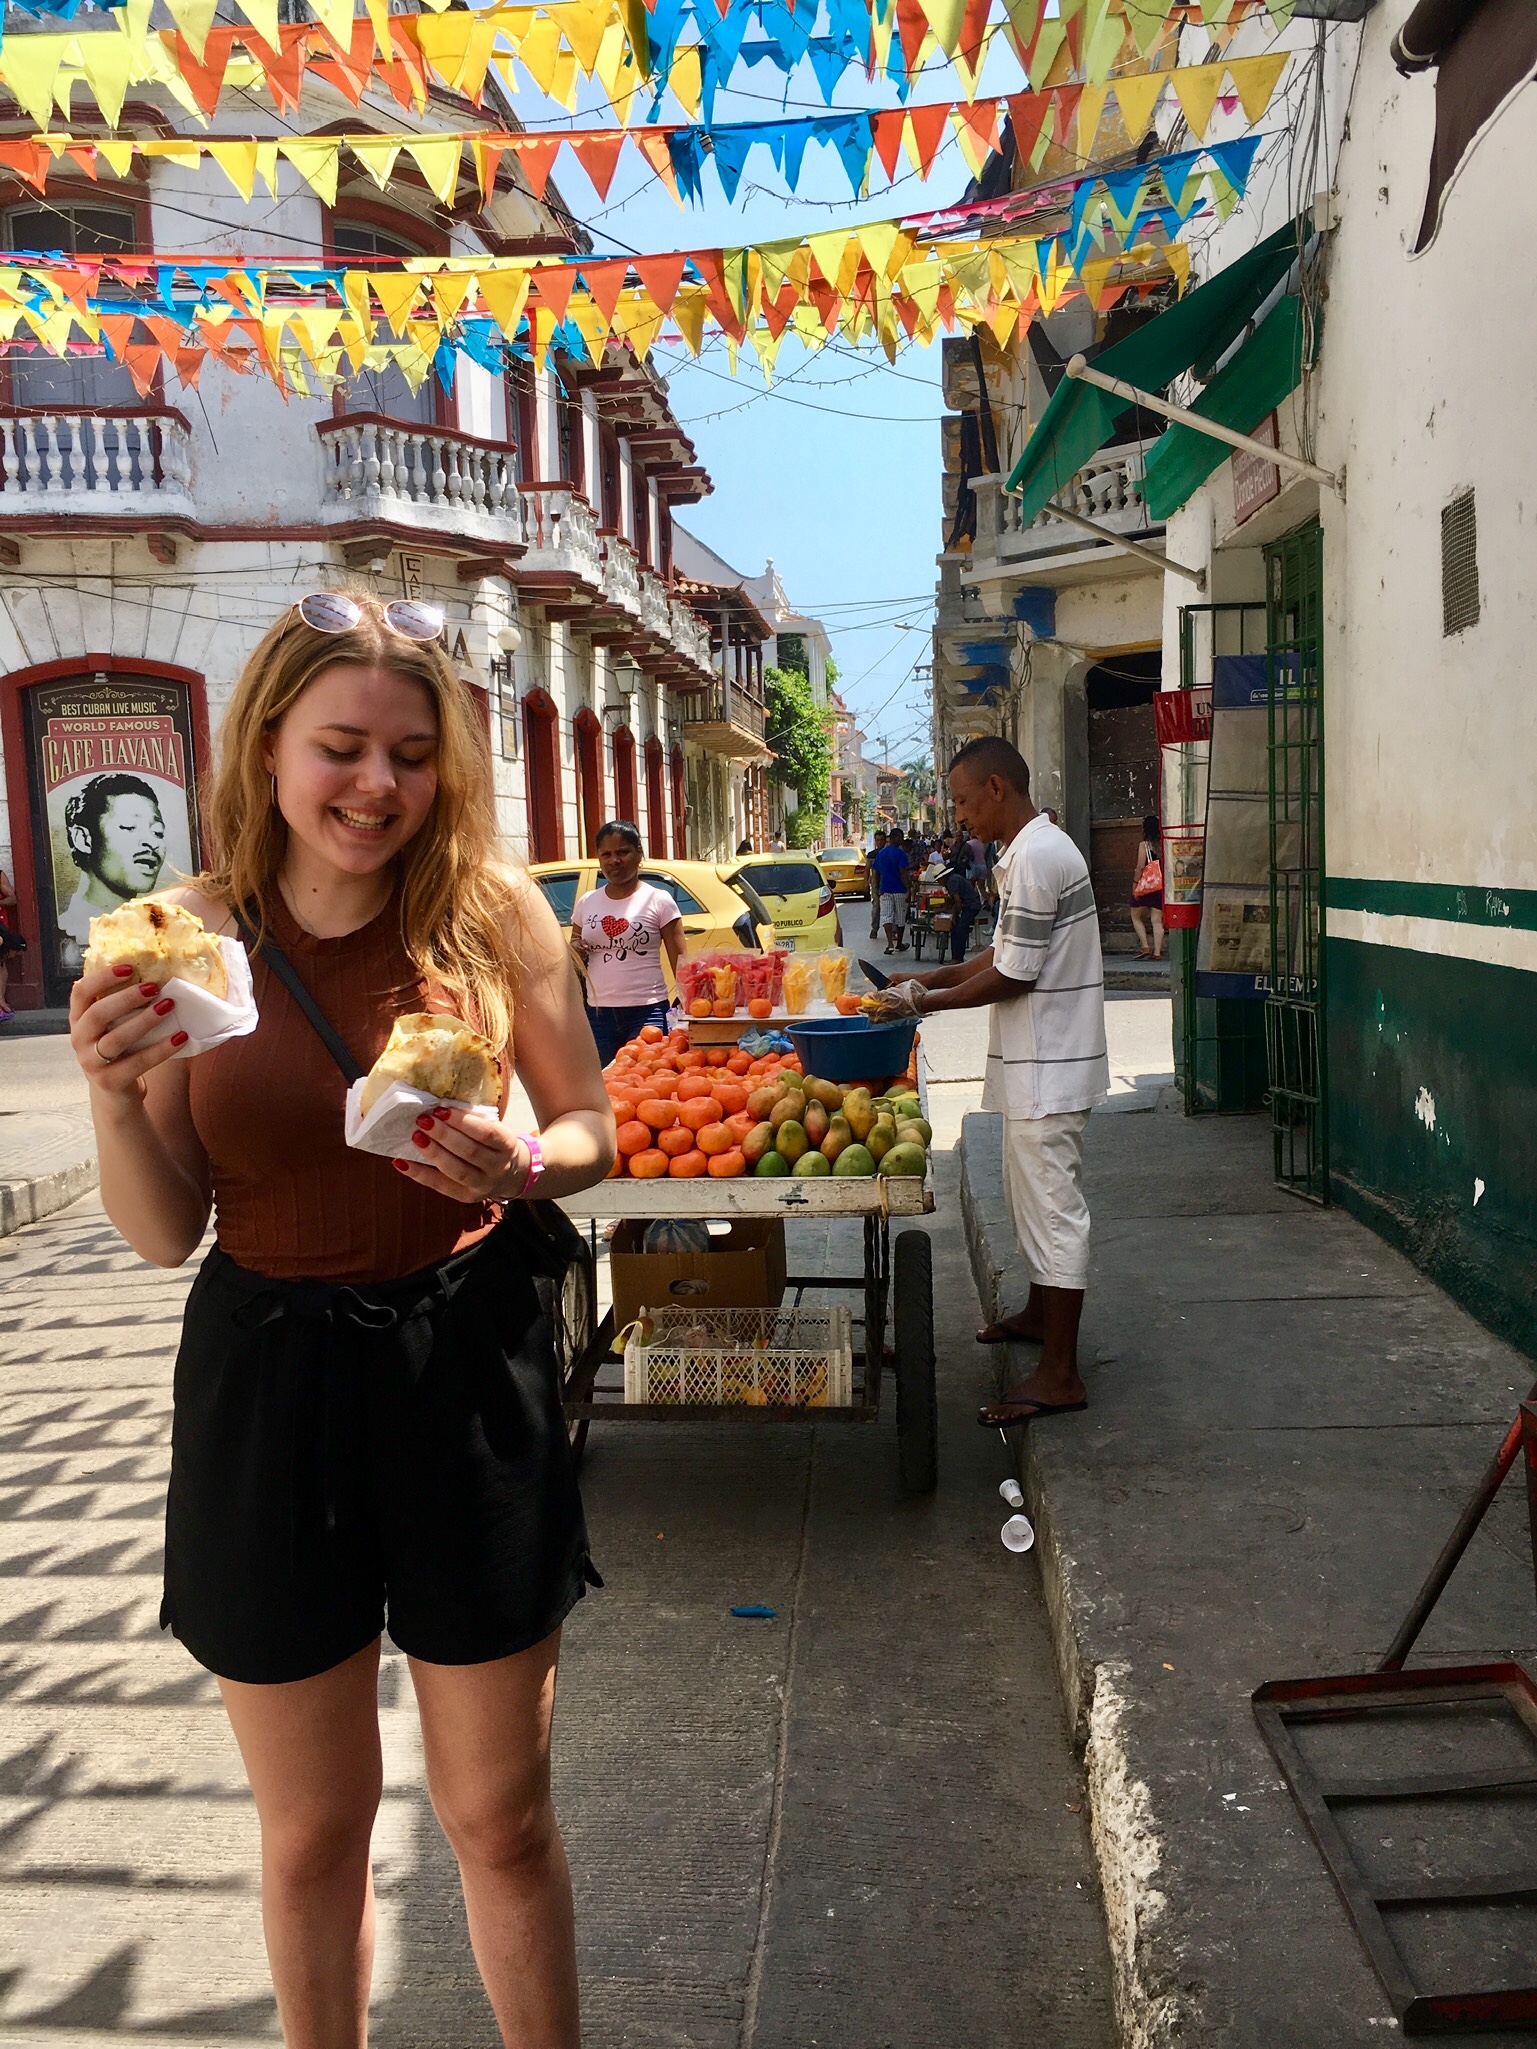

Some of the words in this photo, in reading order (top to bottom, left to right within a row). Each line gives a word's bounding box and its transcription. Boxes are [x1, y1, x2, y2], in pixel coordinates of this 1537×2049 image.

[406, 557, 421, 601] CAF
[61, 703, 81, 716] BEST
[83, 702, 111, 716] CUBAN
[113, 702, 130, 714] LIVE
[131, 701, 158, 714] MUSIC
[62, 722, 106, 732] WORLD
[110, 720, 160, 731] FAMOUS
[48, 738, 95, 783] CAFE
[99, 737, 181, 780] HAVANA
[781, 919, 803, 927] PUBLICO
[590, 937, 648, 961] eautiful
[1254, 975, 1272, 991] EL
